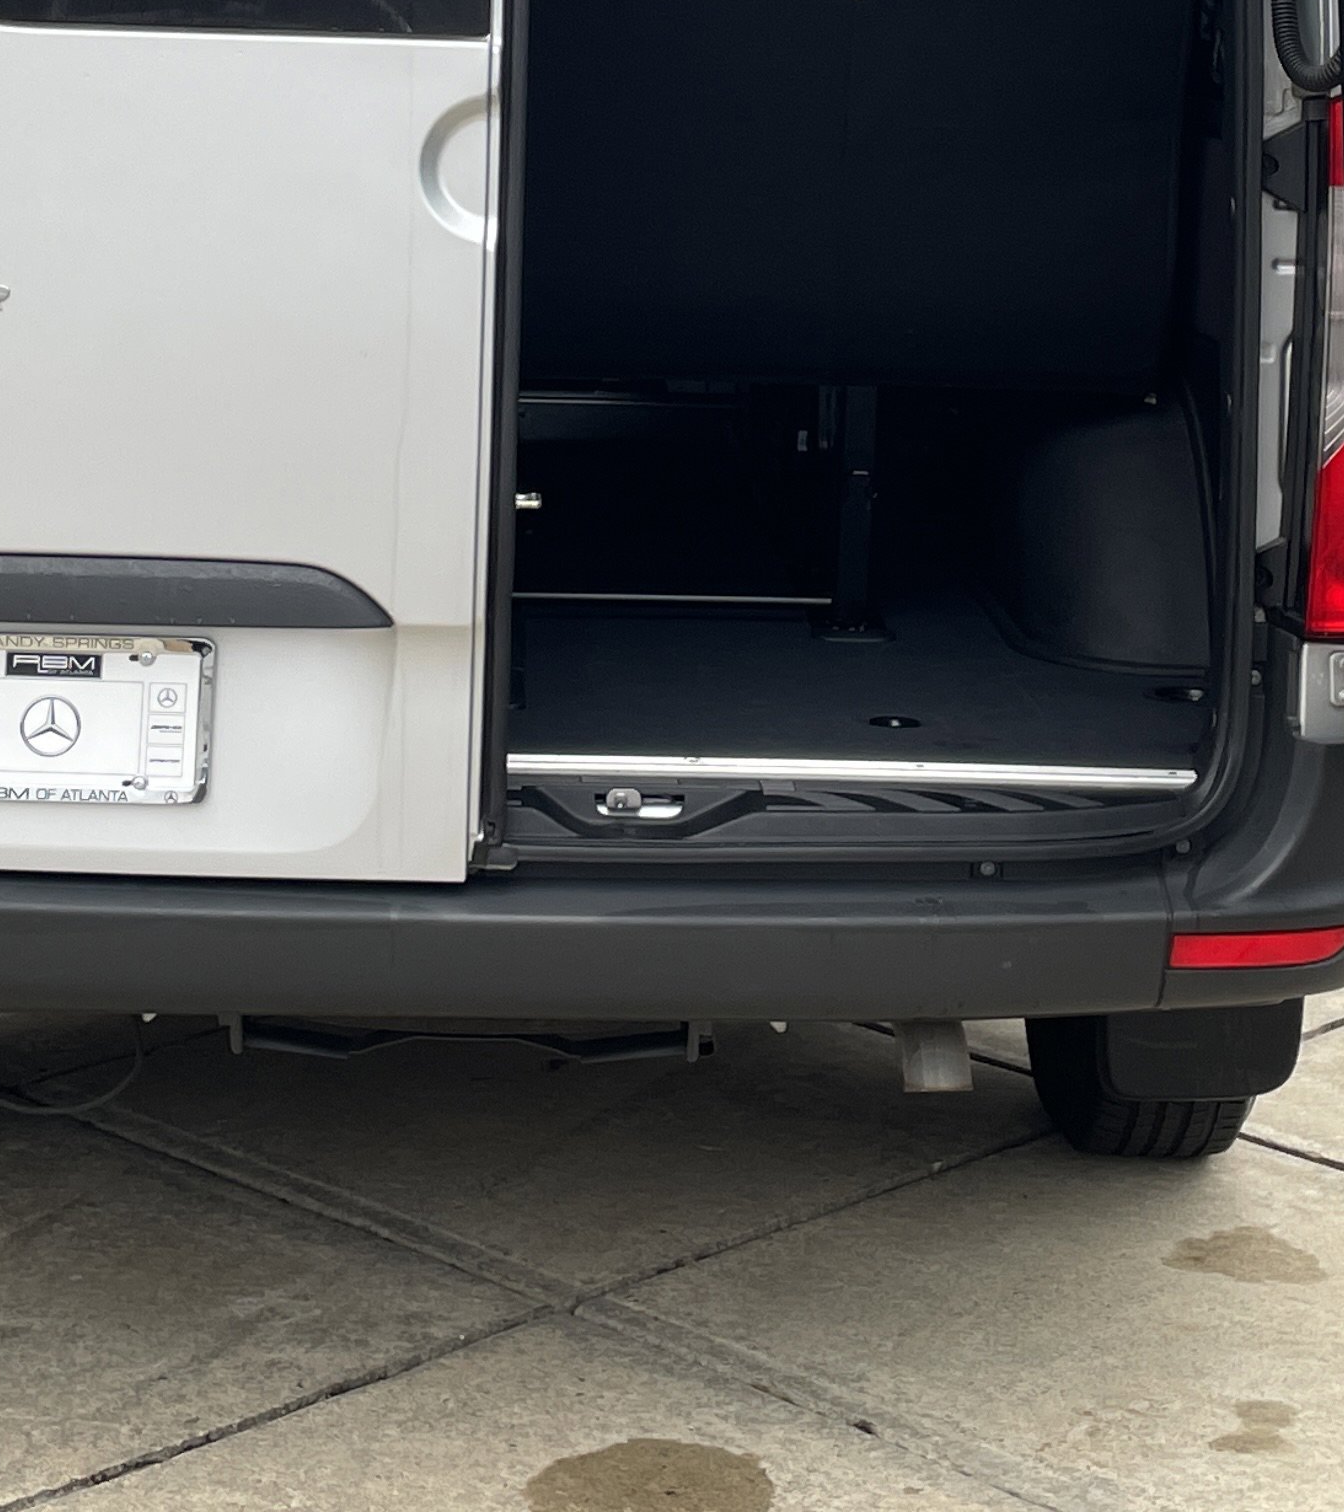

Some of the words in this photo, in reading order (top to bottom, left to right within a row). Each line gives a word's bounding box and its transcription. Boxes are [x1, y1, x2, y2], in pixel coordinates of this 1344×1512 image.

[52, 636, 135, 651] SPRINGS
[12, 654, 96, 674] RBM
[35, 787, 57, 801] OF
[60, 788, 129, 803] ATLANTA
